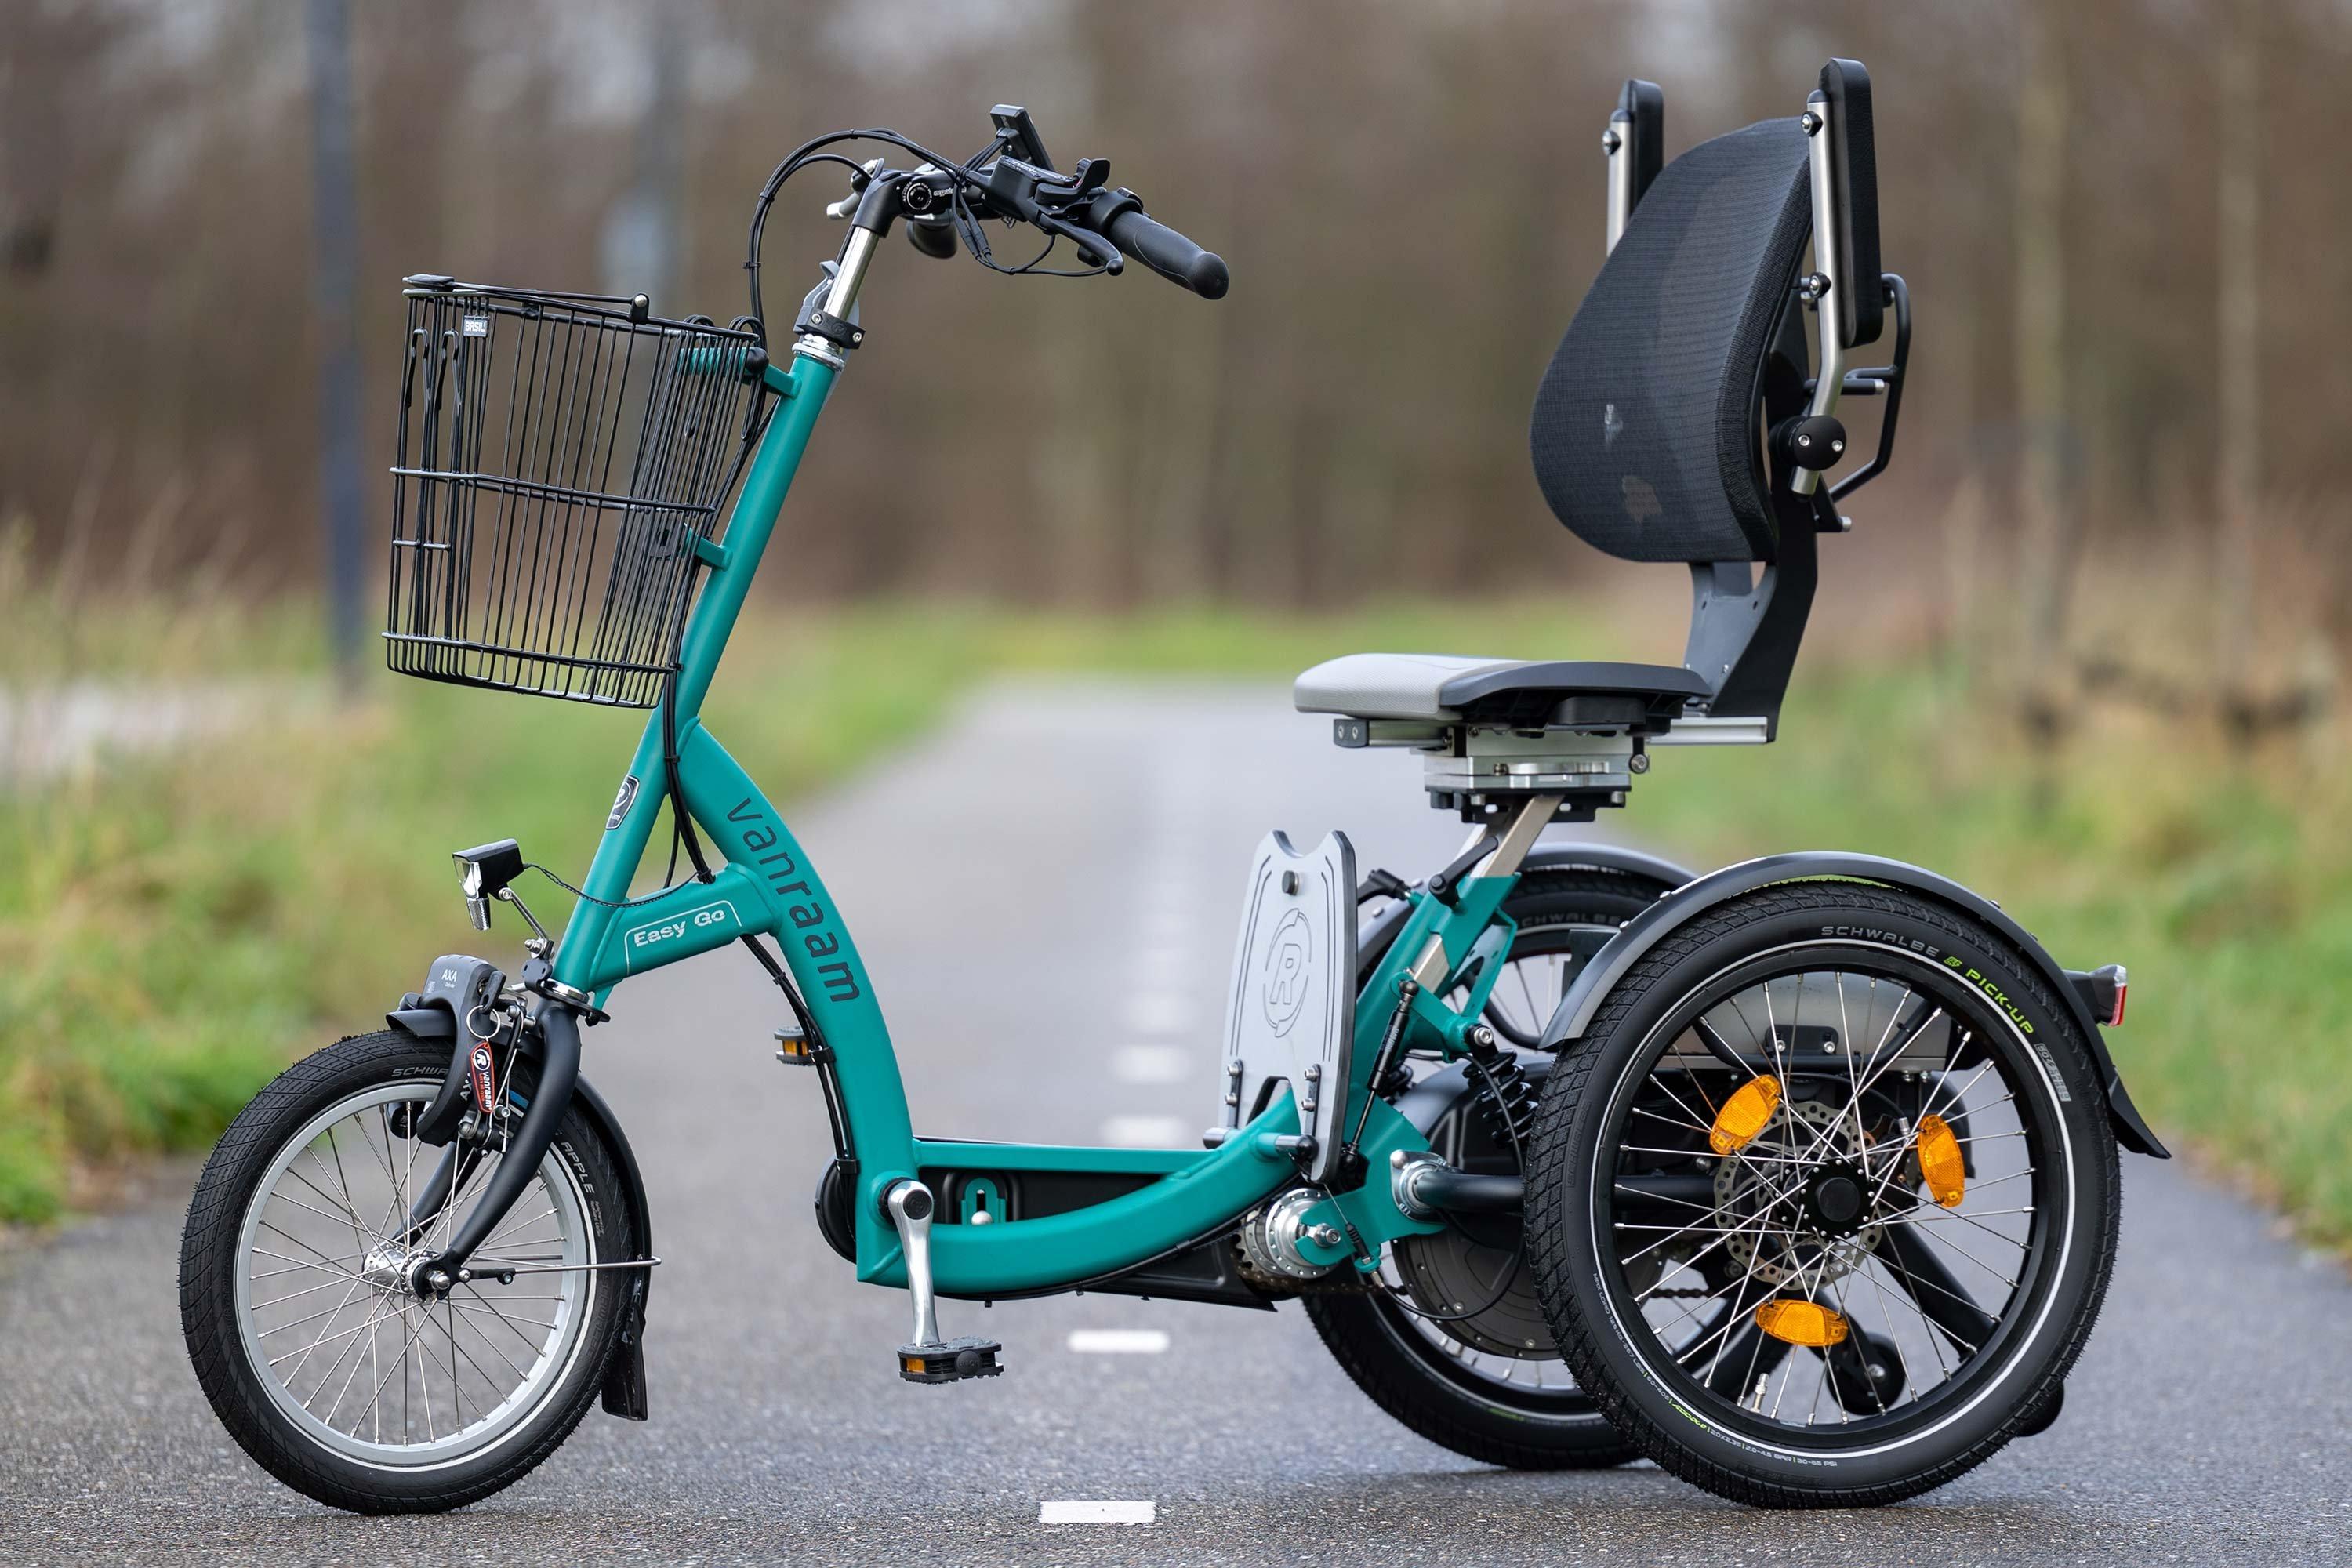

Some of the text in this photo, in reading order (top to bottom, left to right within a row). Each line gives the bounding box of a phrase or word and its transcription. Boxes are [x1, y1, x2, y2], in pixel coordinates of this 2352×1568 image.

[727, 797, 860, 1003] vanraam
[633, 909, 725, 947] Easy Go
[1516, 912, 1620, 927] CHWALBE
[1820, 926, 1940, 957] SCHWALBE
[441, 969, 457, 982] AXA
[1965, 968, 2034, 1034] PICK-UP
[391, 1066, 450, 1077] SCHWA
[482, 1071, 492, 1108] vanraam
[561, 1142, 595, 1193] APPLE
[1593, 1273, 1602, 1291] MAX
[1599, 1292, 1610, 1315] LOAD
[1633, 1358, 1645, 1374] LBS
[1774, 1454, 1792, 1463] BAR
